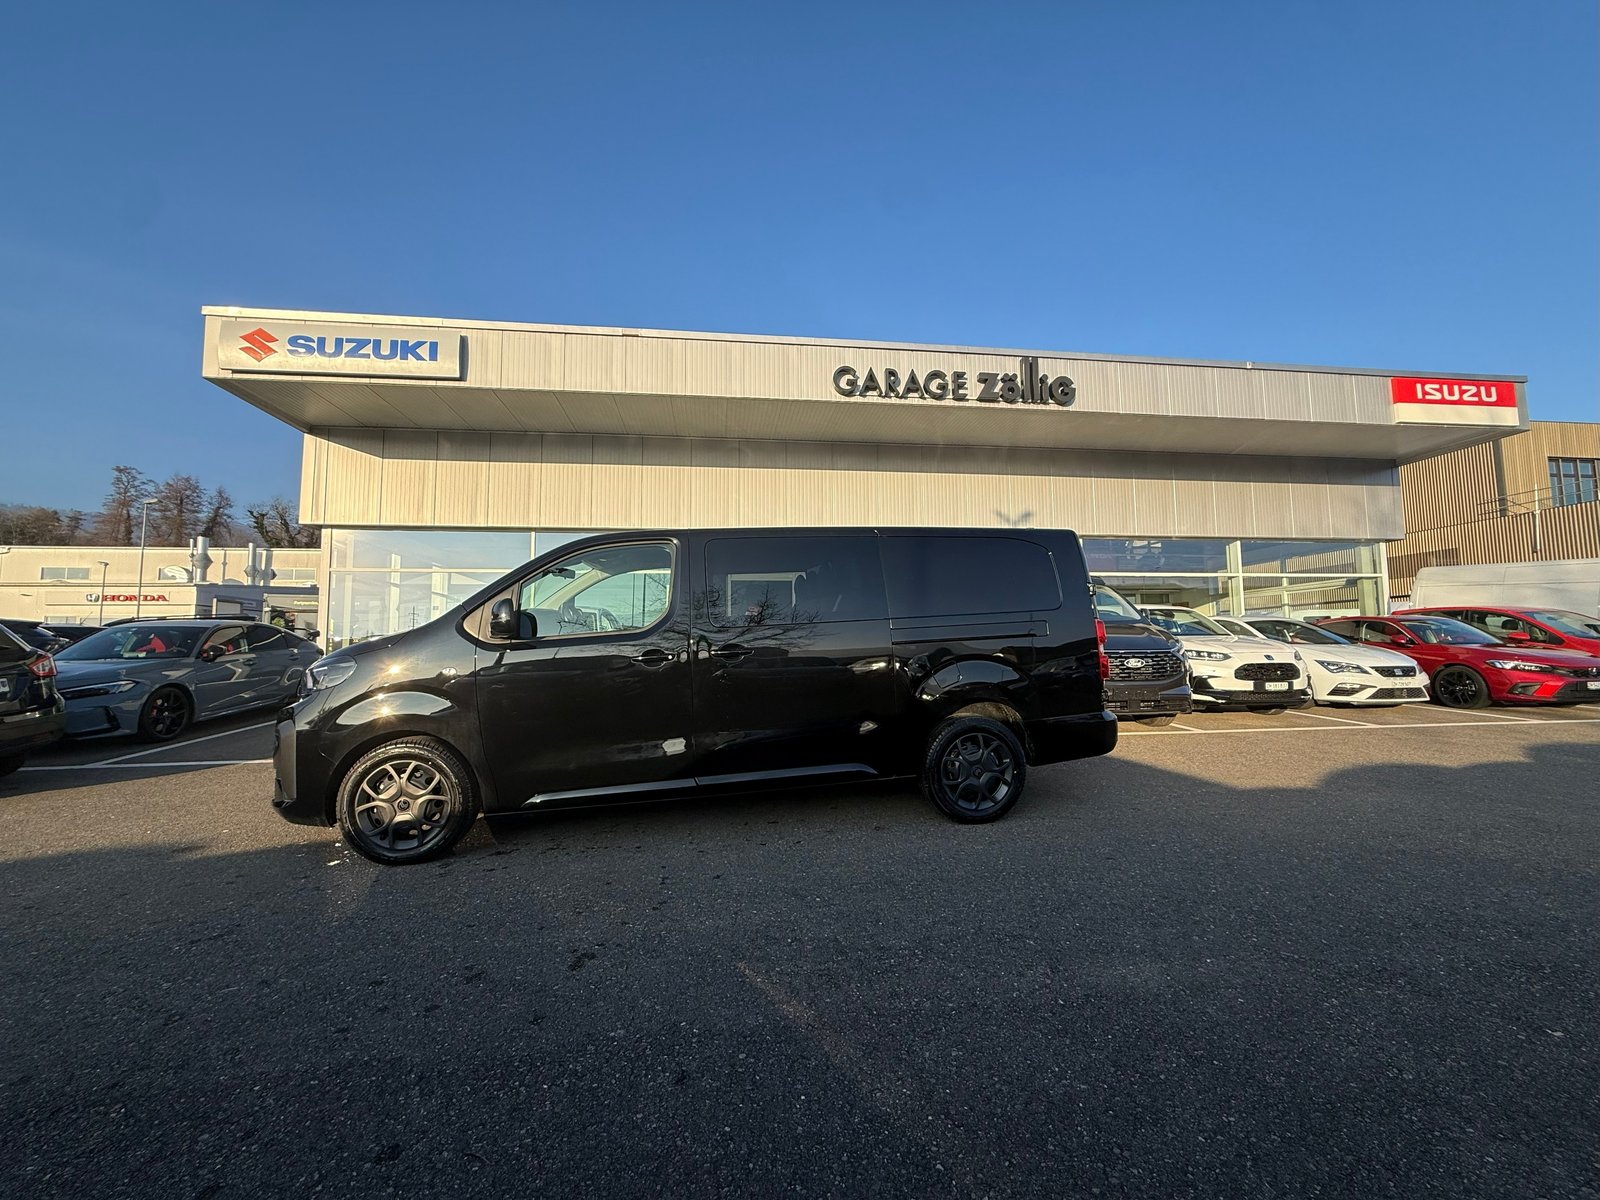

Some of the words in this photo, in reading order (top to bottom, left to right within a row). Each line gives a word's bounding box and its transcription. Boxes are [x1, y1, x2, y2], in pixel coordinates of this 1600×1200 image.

[286, 334, 439, 362] SUZUKI
[833, 365, 970, 401] GARAGE
[1415, 383, 1498, 402] ISUZU
[102, 594, 169, 602] HONDA
